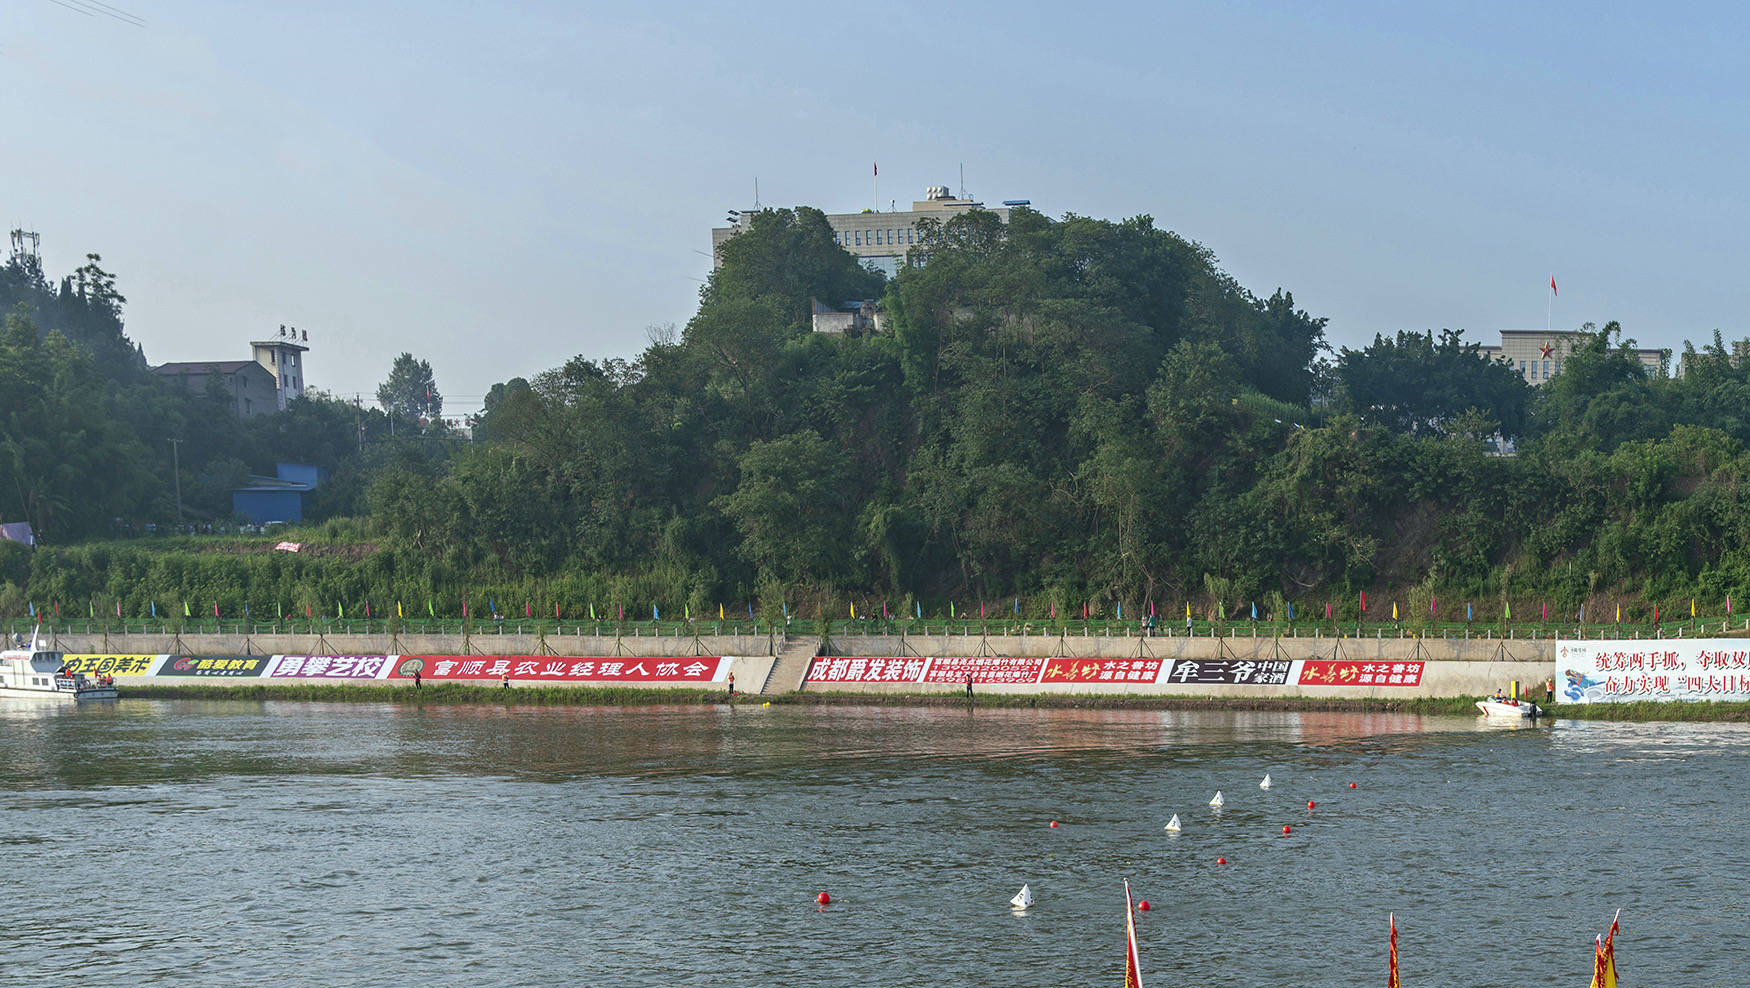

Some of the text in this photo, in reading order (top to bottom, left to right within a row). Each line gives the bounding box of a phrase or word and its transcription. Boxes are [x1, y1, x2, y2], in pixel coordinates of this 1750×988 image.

[432, 659, 711, 677] 富顺县农业经理人协会
[1103, 661, 1159, 670] 水之善坊
[1361, 664, 1421, 673] 水之善坊
[1098, 671, 1155, 680] 源自健康
[1358, 674, 1418, 683] 源自健康
